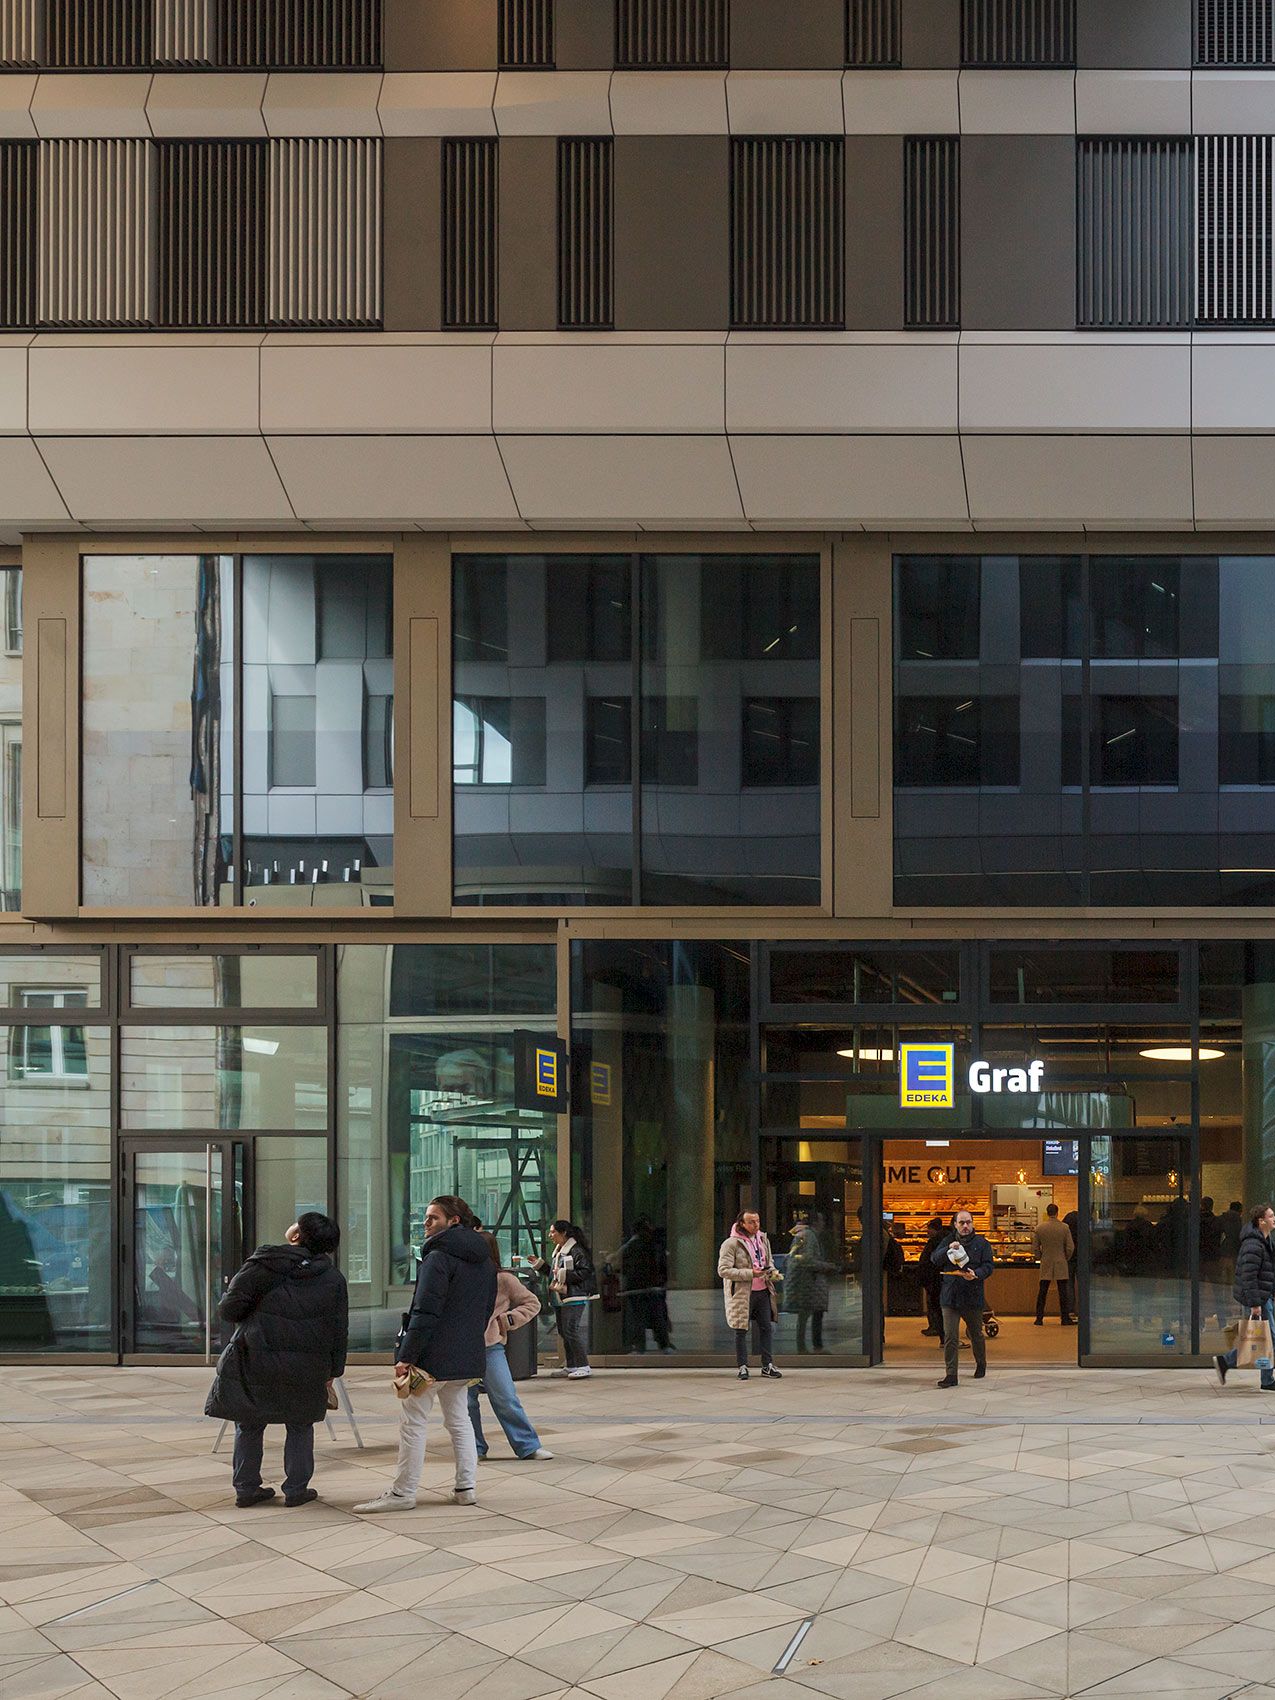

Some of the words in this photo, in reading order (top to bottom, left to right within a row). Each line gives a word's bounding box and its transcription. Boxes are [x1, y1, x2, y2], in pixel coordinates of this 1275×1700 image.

[968, 1059, 1045, 1093] Graf
[906, 1094, 948, 1102] EDEKA
[883, 1166, 921, 1184] IME
[927, 1165, 976, 1184] OUT
